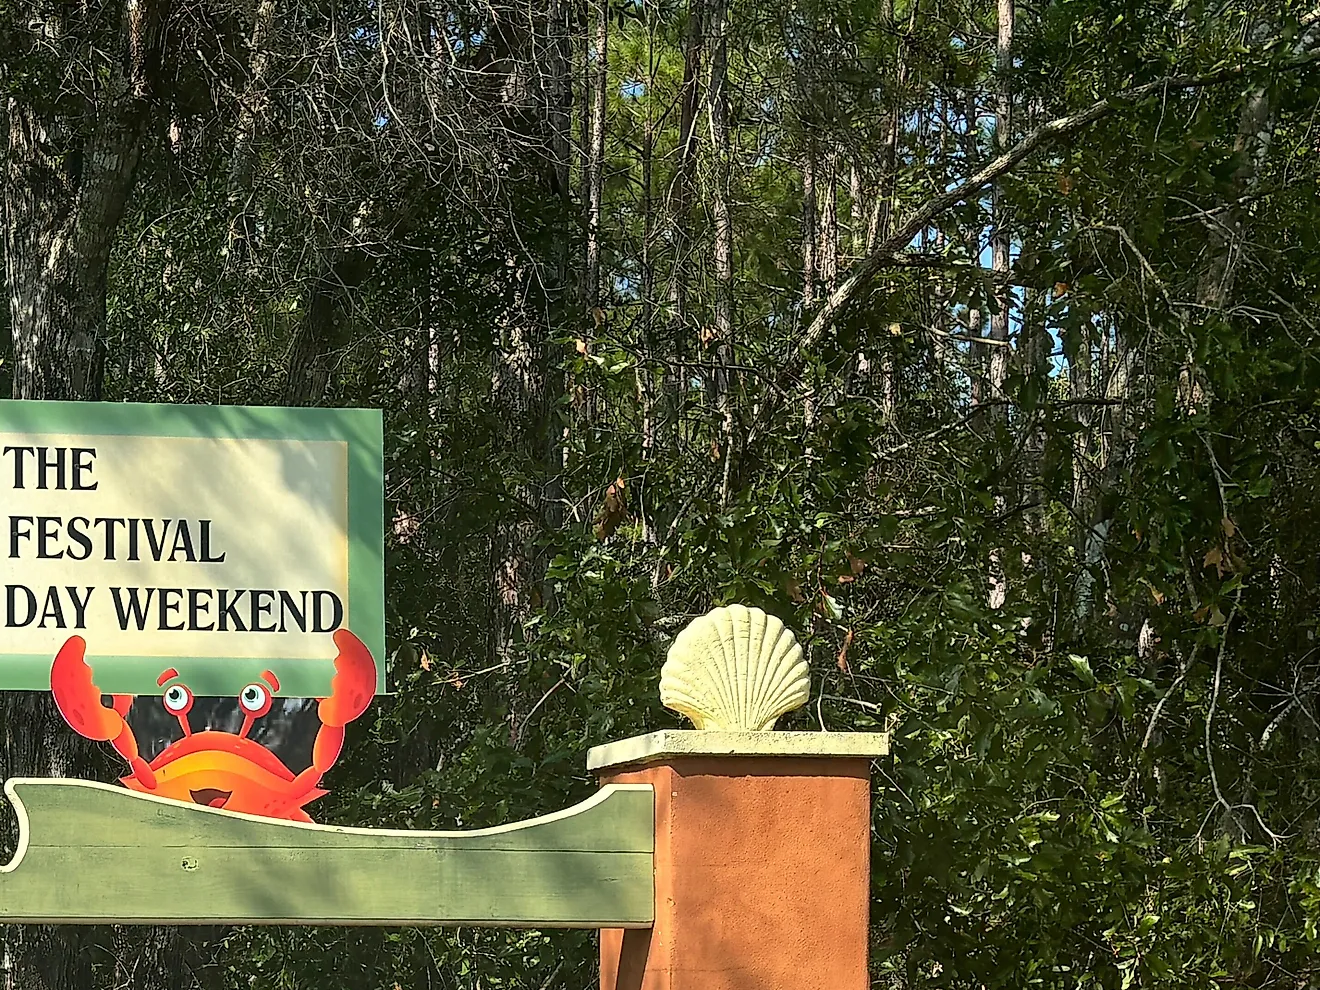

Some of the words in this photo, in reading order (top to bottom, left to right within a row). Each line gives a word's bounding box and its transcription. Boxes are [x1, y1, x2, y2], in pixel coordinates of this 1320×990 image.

[2, 446, 99, 491] THE
[8, 515, 226, 563] FESTIVAL
[4, 584, 96, 629] DAY
[108, 586, 344, 633] WEEKEND
